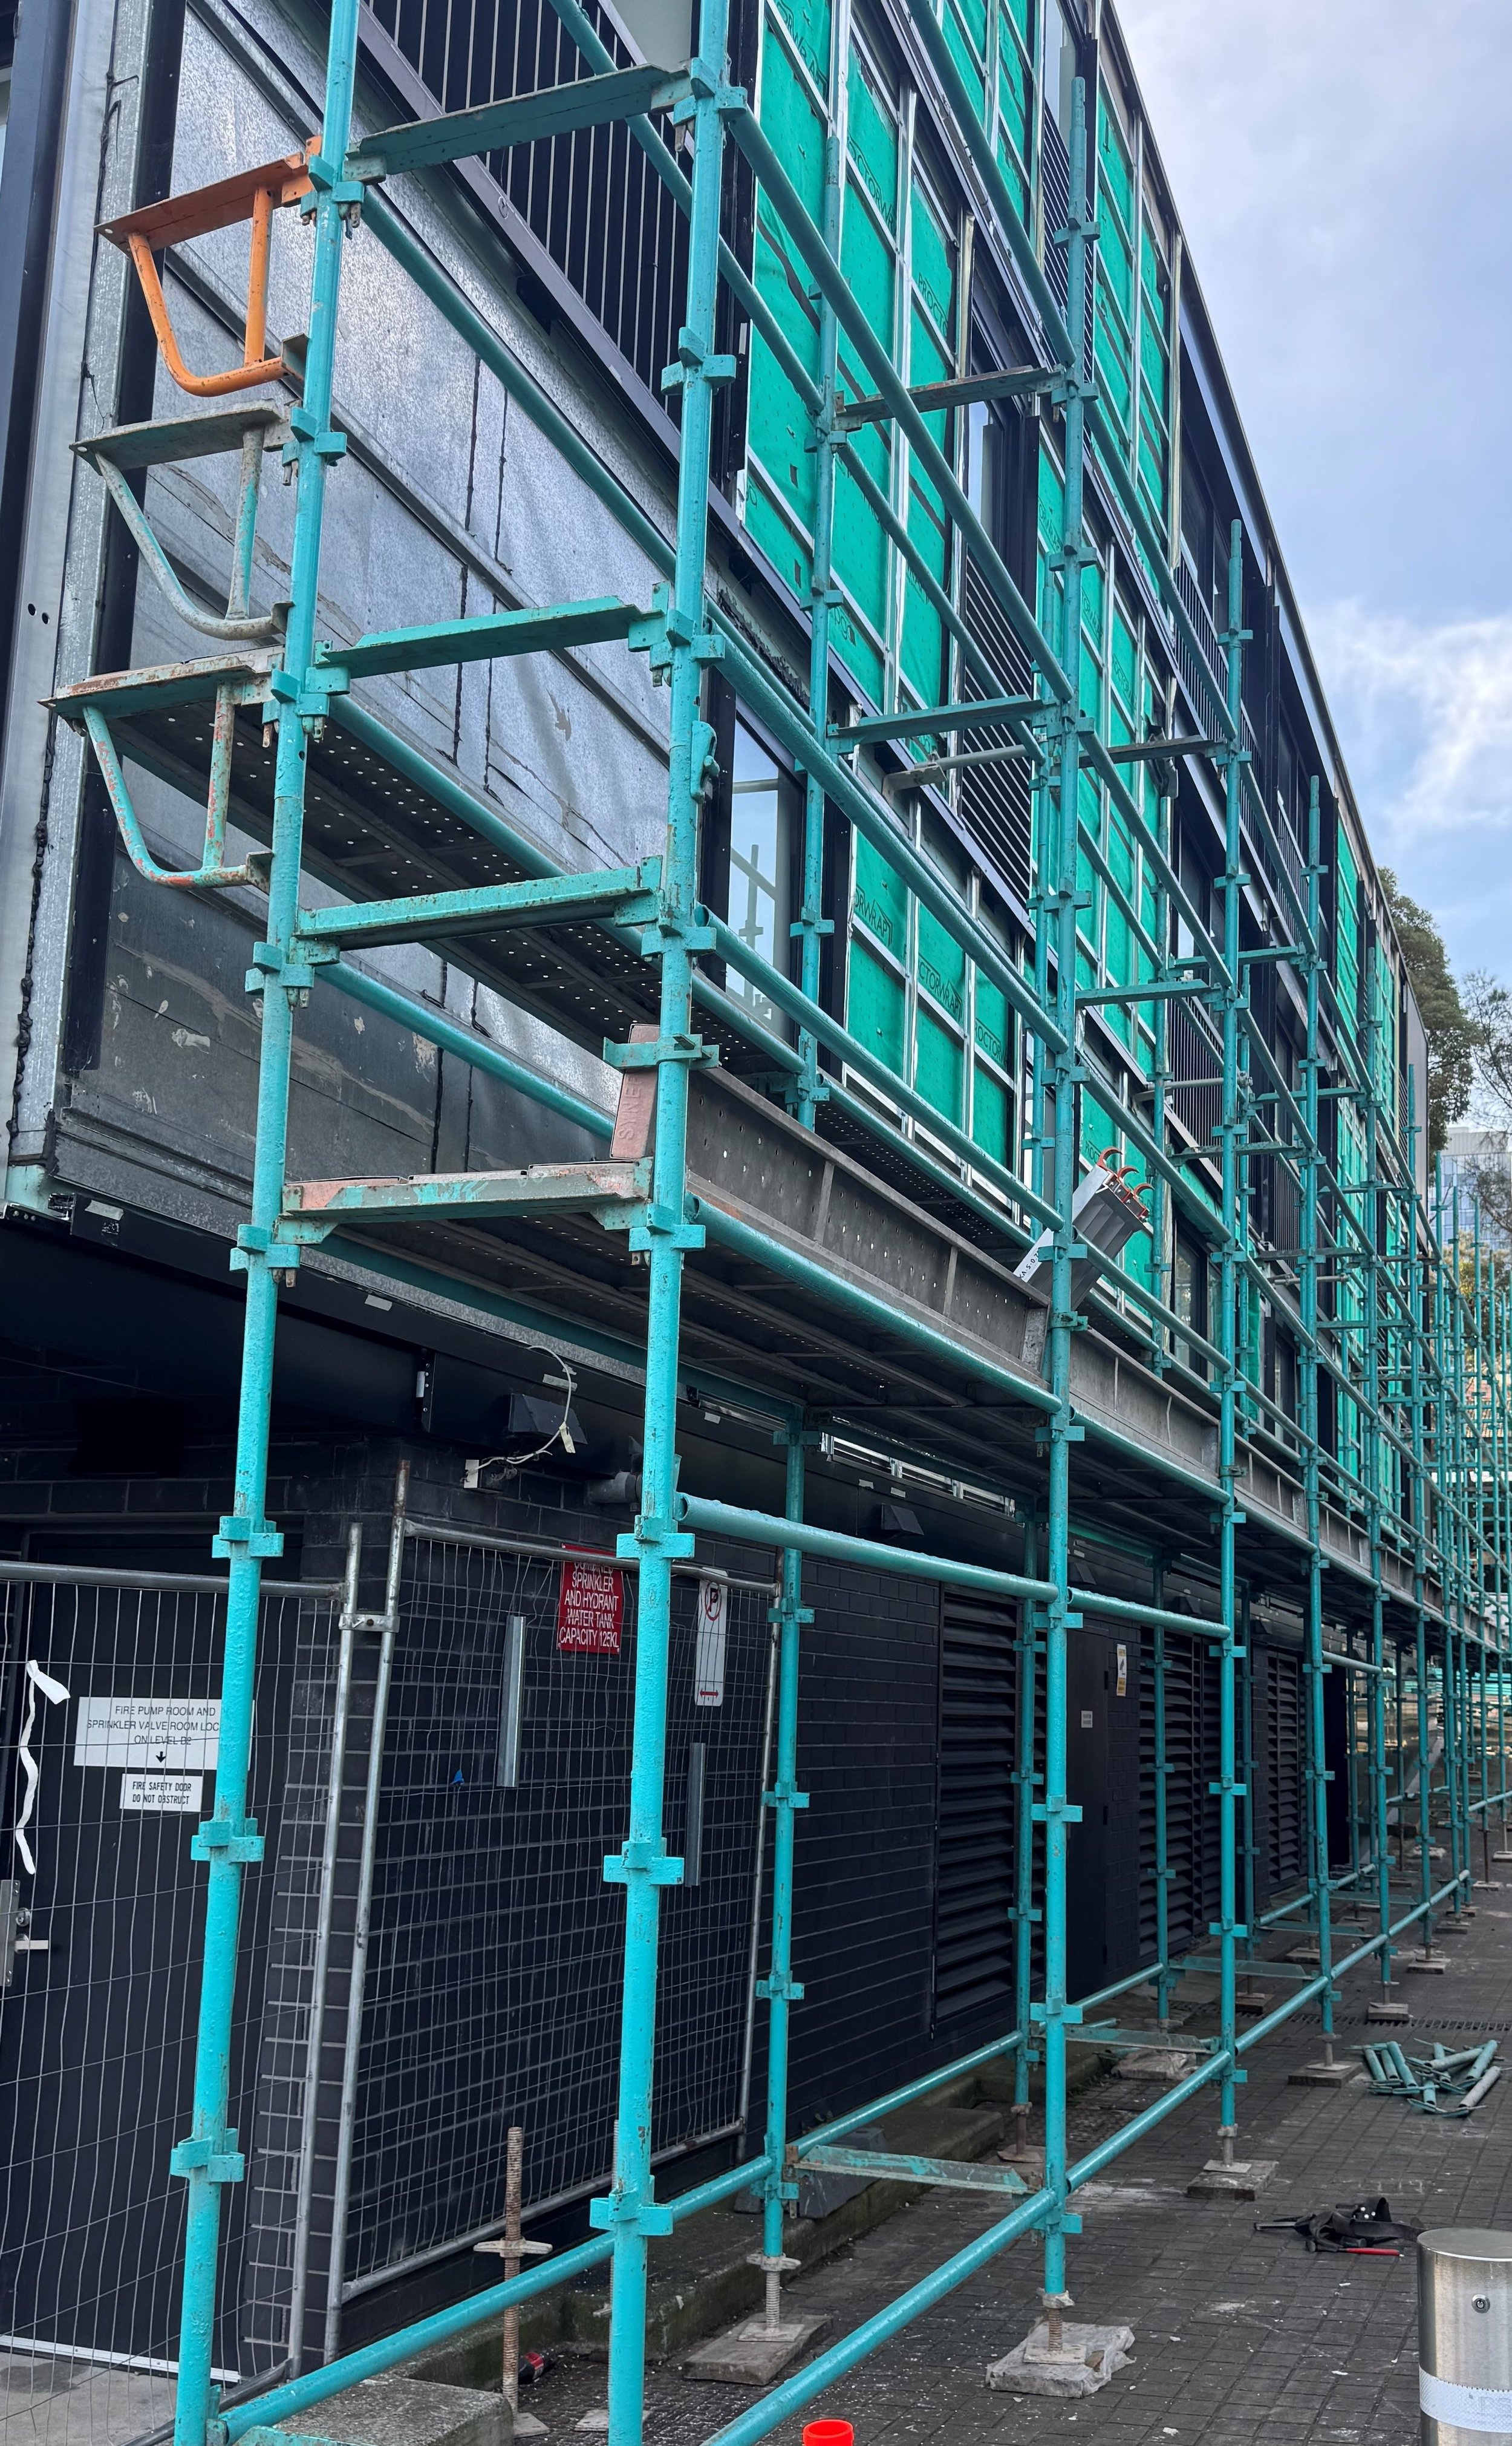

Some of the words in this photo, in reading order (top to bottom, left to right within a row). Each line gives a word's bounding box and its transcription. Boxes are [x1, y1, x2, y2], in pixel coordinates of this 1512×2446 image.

[572, 1571, 613, 1592] SPRINKLER
[564, 1589, 581, 1607] AND
[583, 1592, 619, 1611] HYDRANT
[567, 1608, 593, 1627] WATER
[596, 1612, 614, 1629] TANK
[559, 1626, 598, 1646] CAPACITY
[116, 1705, 135, 1715] FIRE
[138, 1706, 164, 1715] PUMP
[166, 1707, 194, 1716] ROOM
[196, 1707, 216, 1716] AND
[86, 1719, 136, 1730] SPRINKLER
[139, 1721, 168, 1730] VALVE
[170, 1722, 198, 1731] ROOM
[134, 1735, 148, 1744] ON
[151, 1735, 178, 1745] LEVEL
[132, 1781, 146, 1790] FIRE
[149, 1782, 172, 1791] SAFETY
[175, 1782, 192, 1792] DOOR
[132, 1794, 140, 1802] DO
[143, 1794, 155, 1803] NOT
[158, 1795, 189, 1805] OBSTRUCT
